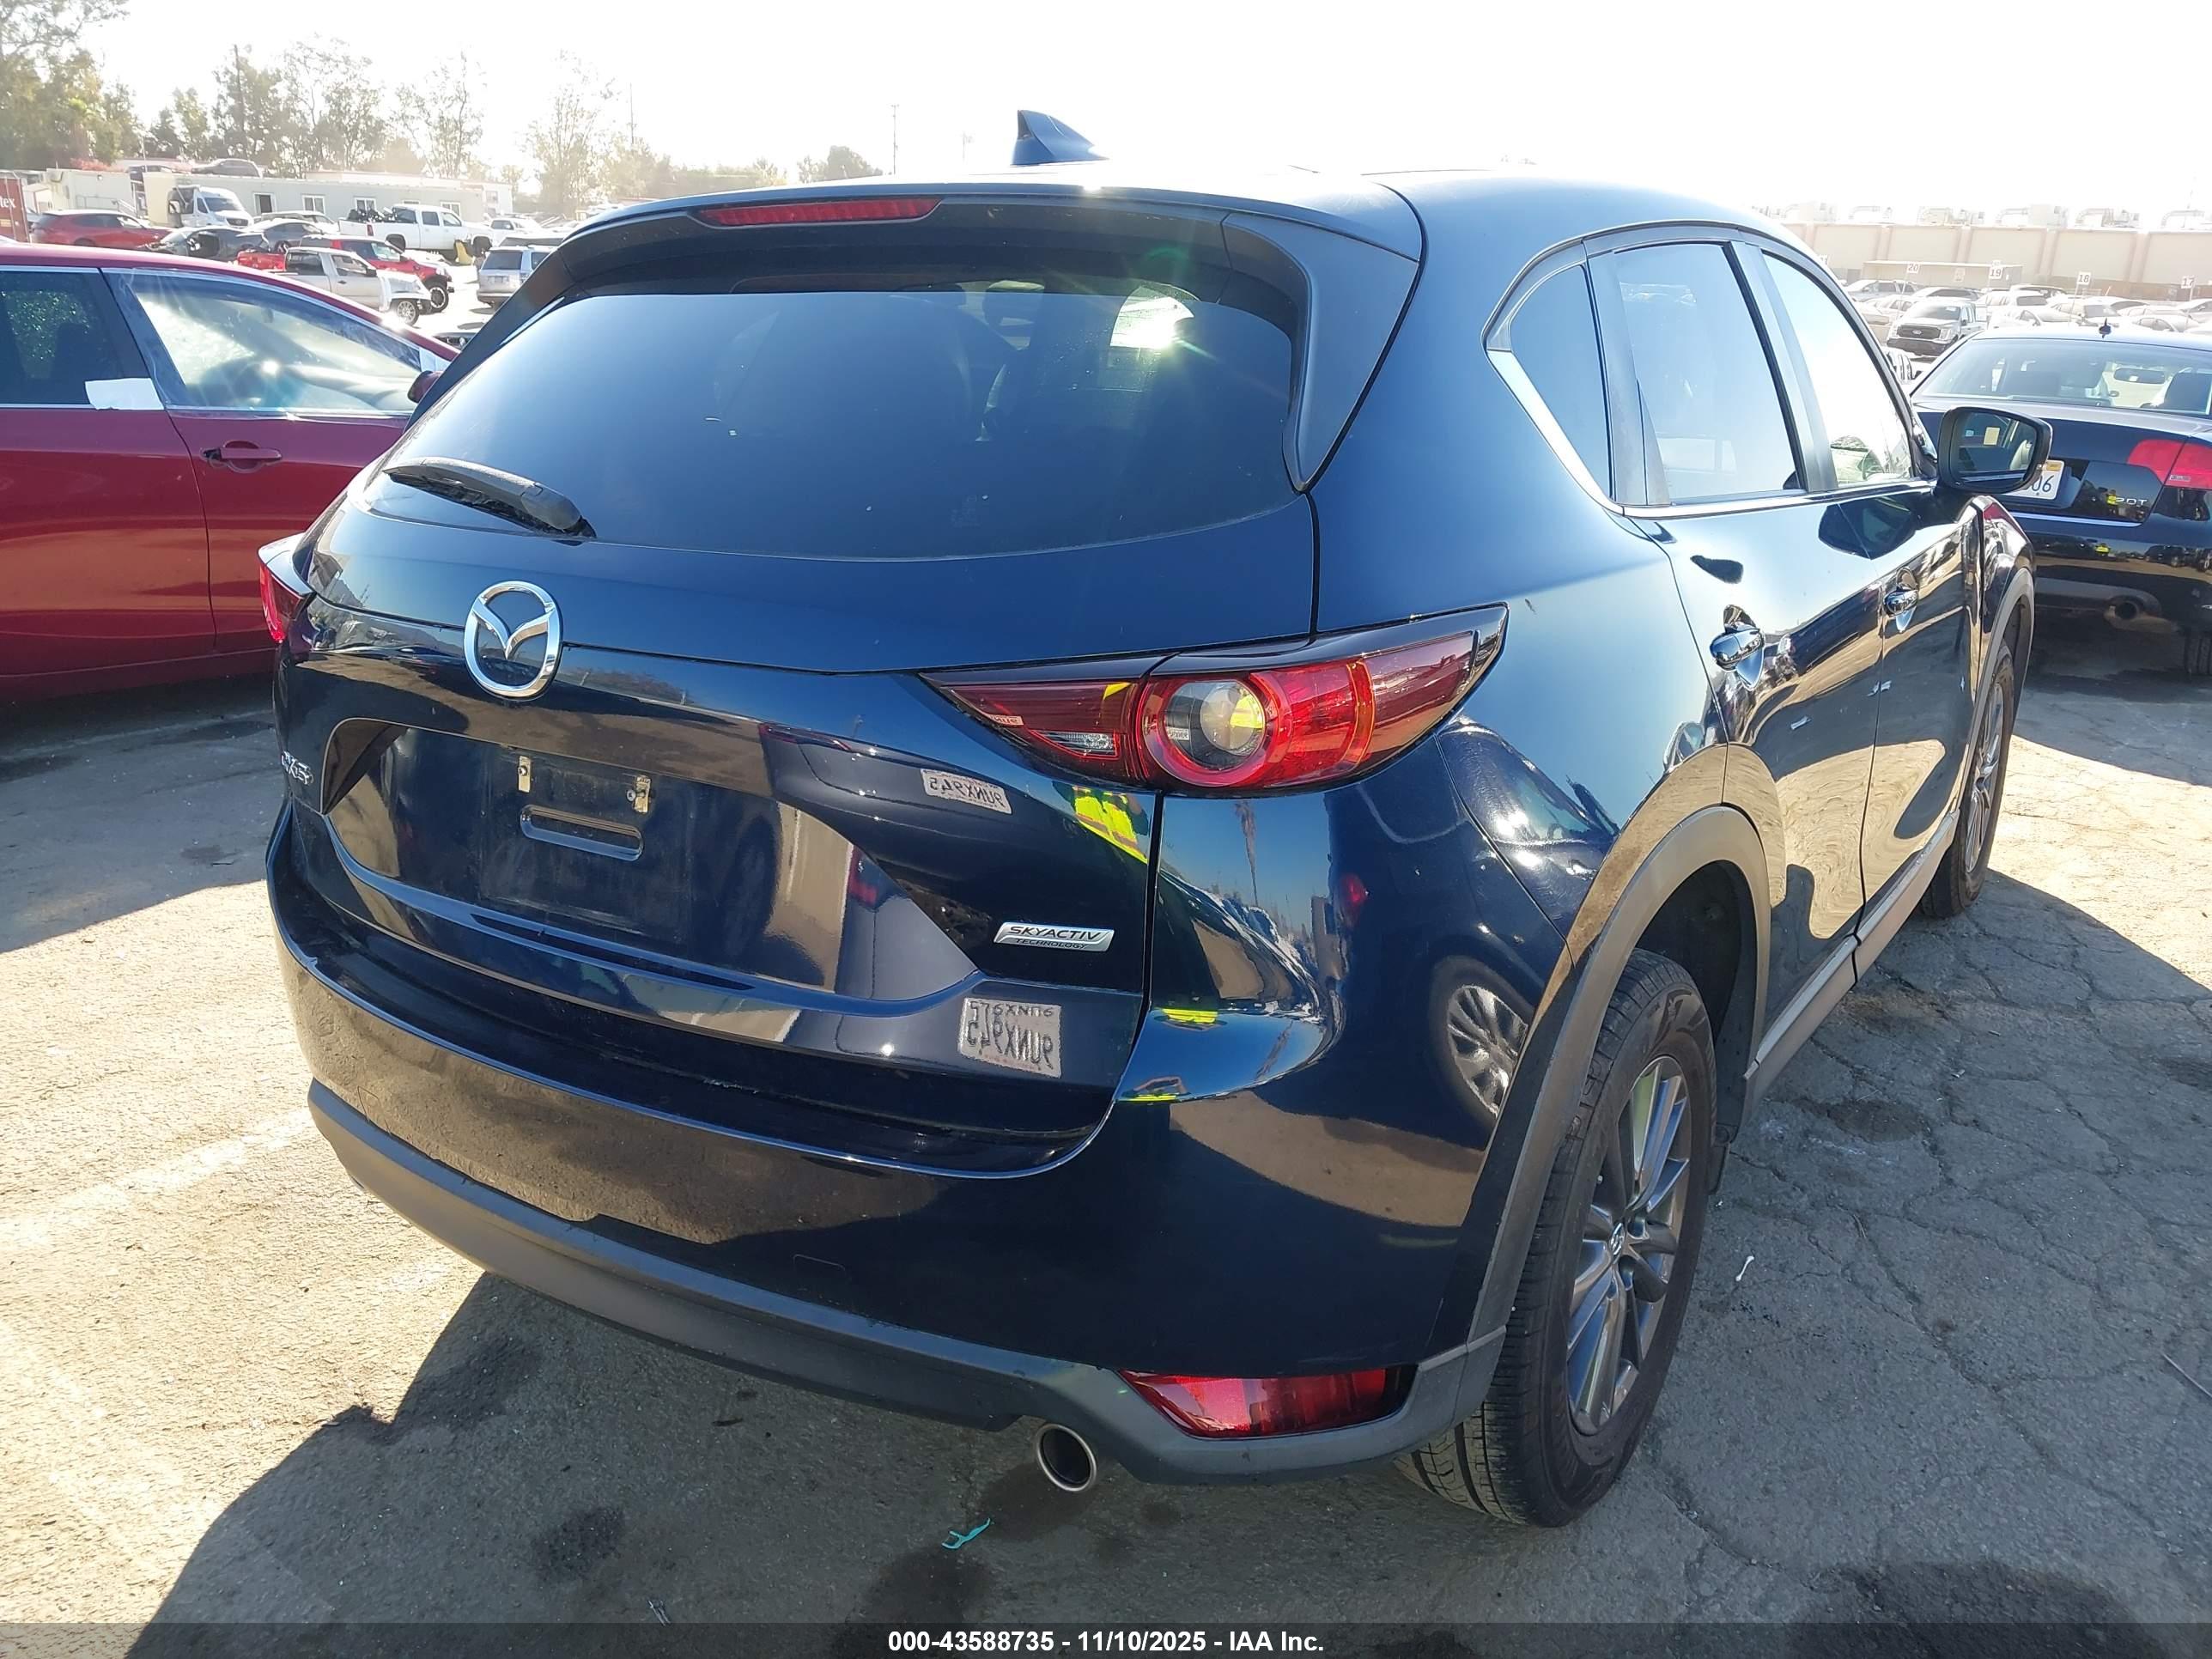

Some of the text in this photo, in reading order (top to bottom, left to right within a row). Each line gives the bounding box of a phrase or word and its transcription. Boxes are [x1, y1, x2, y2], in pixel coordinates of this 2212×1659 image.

[1990, 268, 2002, 277] 19
[2078, 274, 2090, 283] 18
[1009, 926, 1102, 940] SKYACTIV
[1016, 938, 1087, 950] TECHNOLOGY
